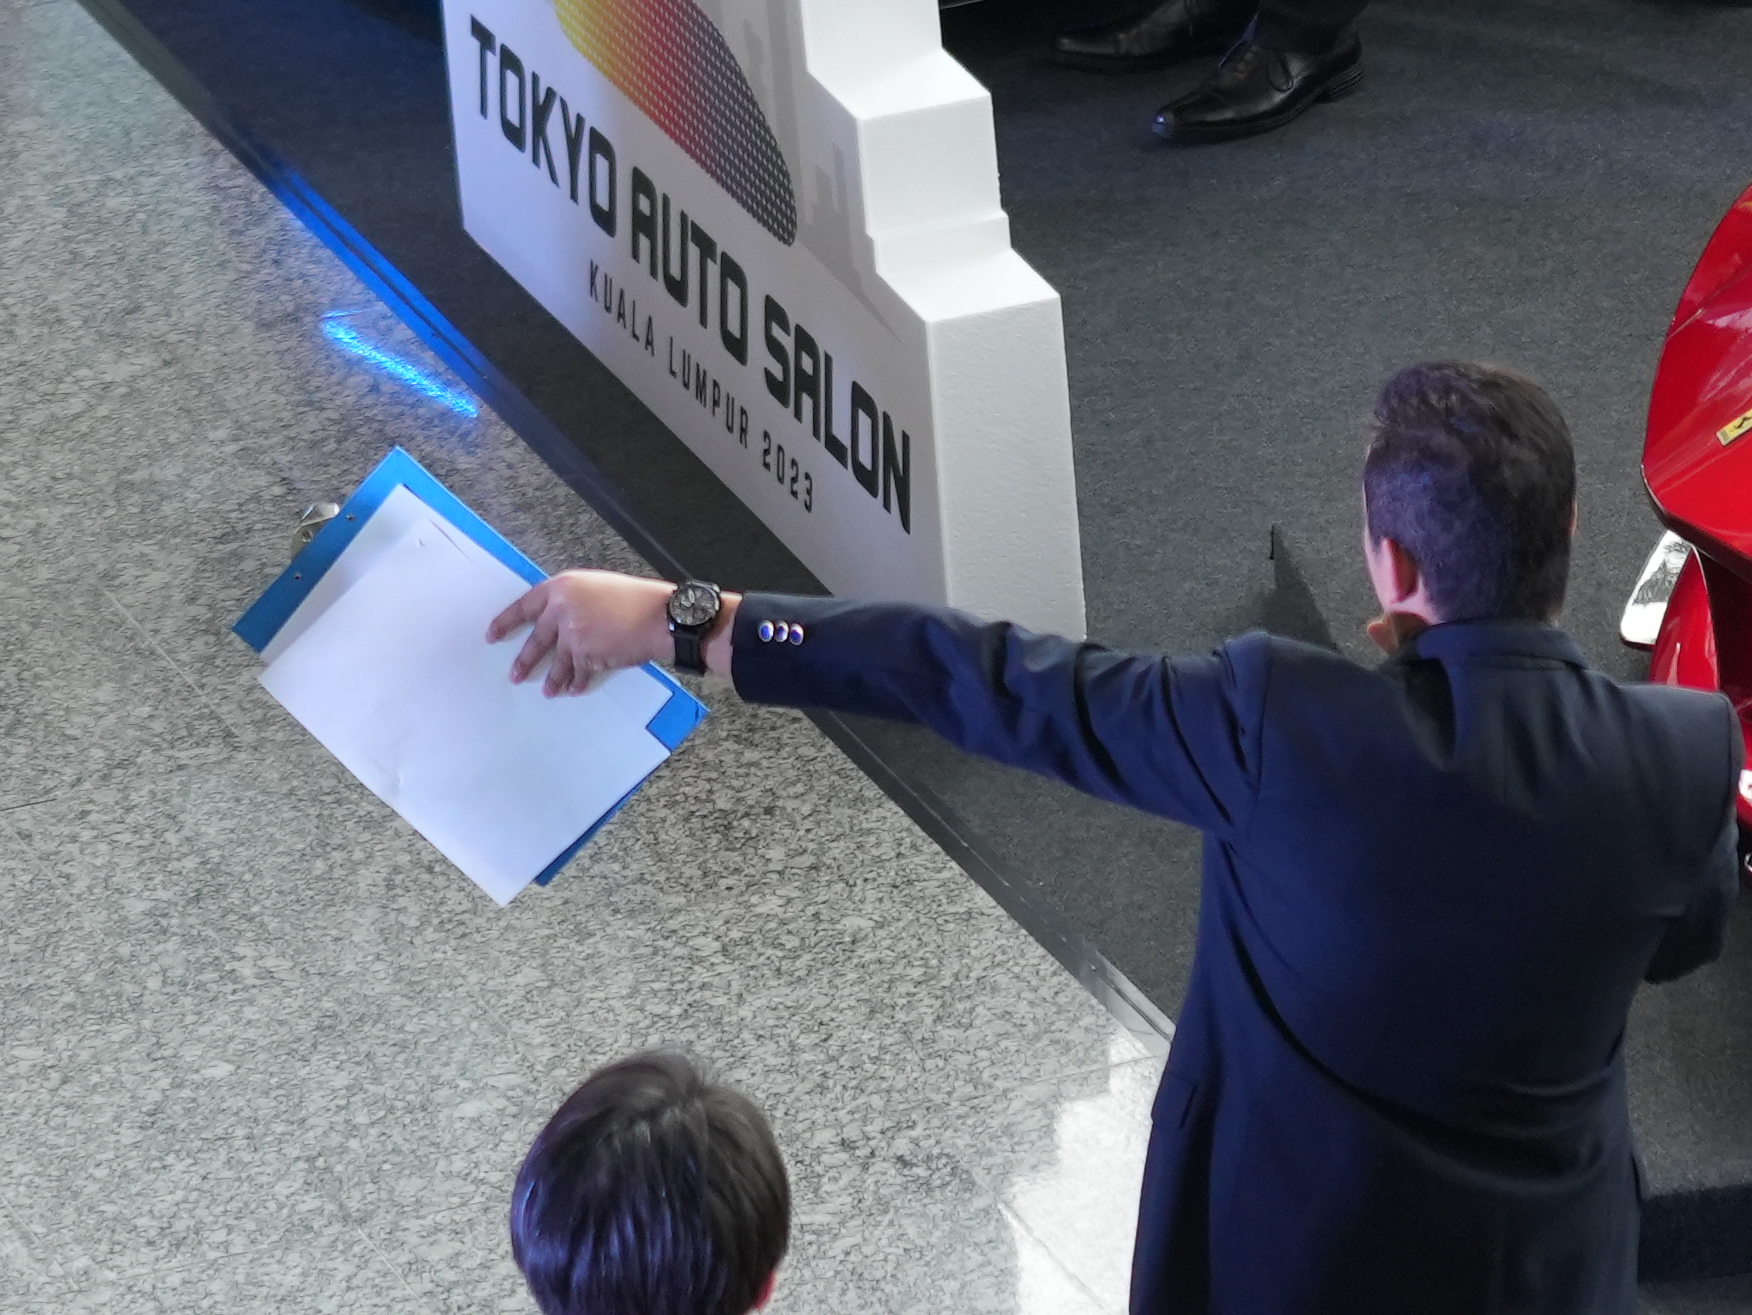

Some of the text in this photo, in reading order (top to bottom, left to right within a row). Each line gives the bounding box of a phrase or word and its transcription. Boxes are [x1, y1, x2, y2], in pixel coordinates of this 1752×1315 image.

[469, 13, 911, 535] TOKYO AUTO SALON
[589, 259, 814, 513] KUALA LUMPUR 2023
